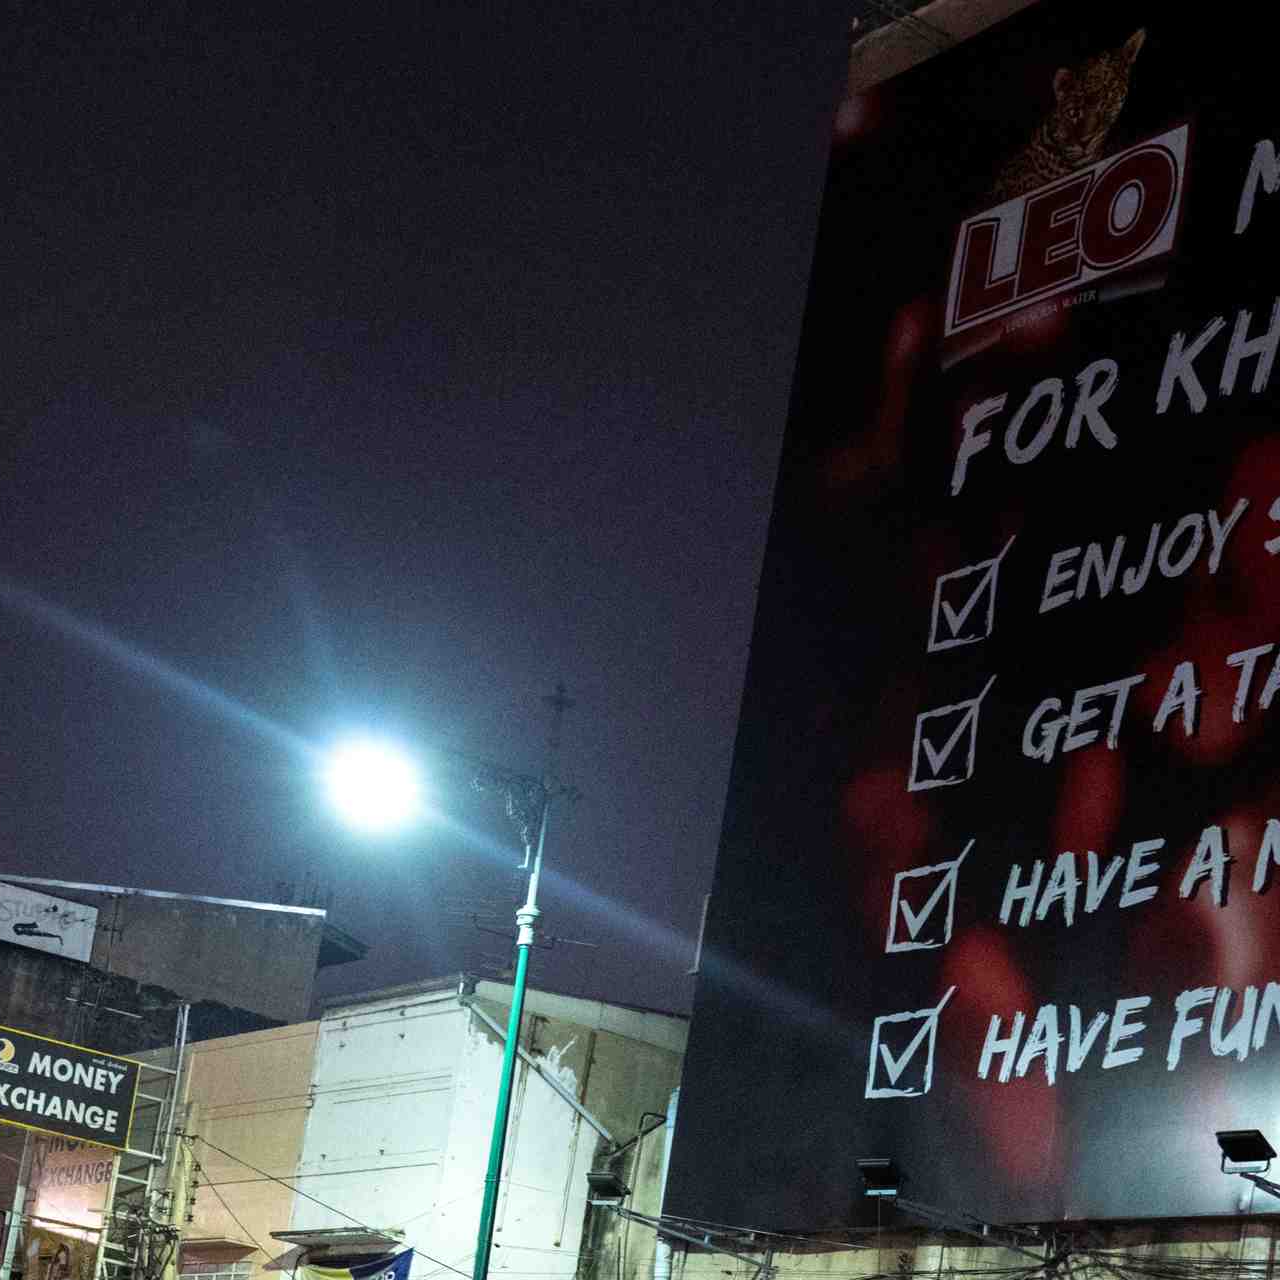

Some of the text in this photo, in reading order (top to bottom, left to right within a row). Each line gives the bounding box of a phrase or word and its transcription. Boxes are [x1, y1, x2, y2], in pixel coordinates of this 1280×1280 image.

[950, 146, 1180, 330] LEO
[950, 358, 1119, 496] FOR
[1039, 497, 1250, 614] ENJOY
[1022, 674, 1147, 763] GET
[1153, 661, 1207, 736] A
[999, 837, 1166, 928] HAVE
[1179, 825, 1231, 907] A
[27, 1051, 125, 1094] MONEY
[977, 995, 1152, 1084] HAVE
